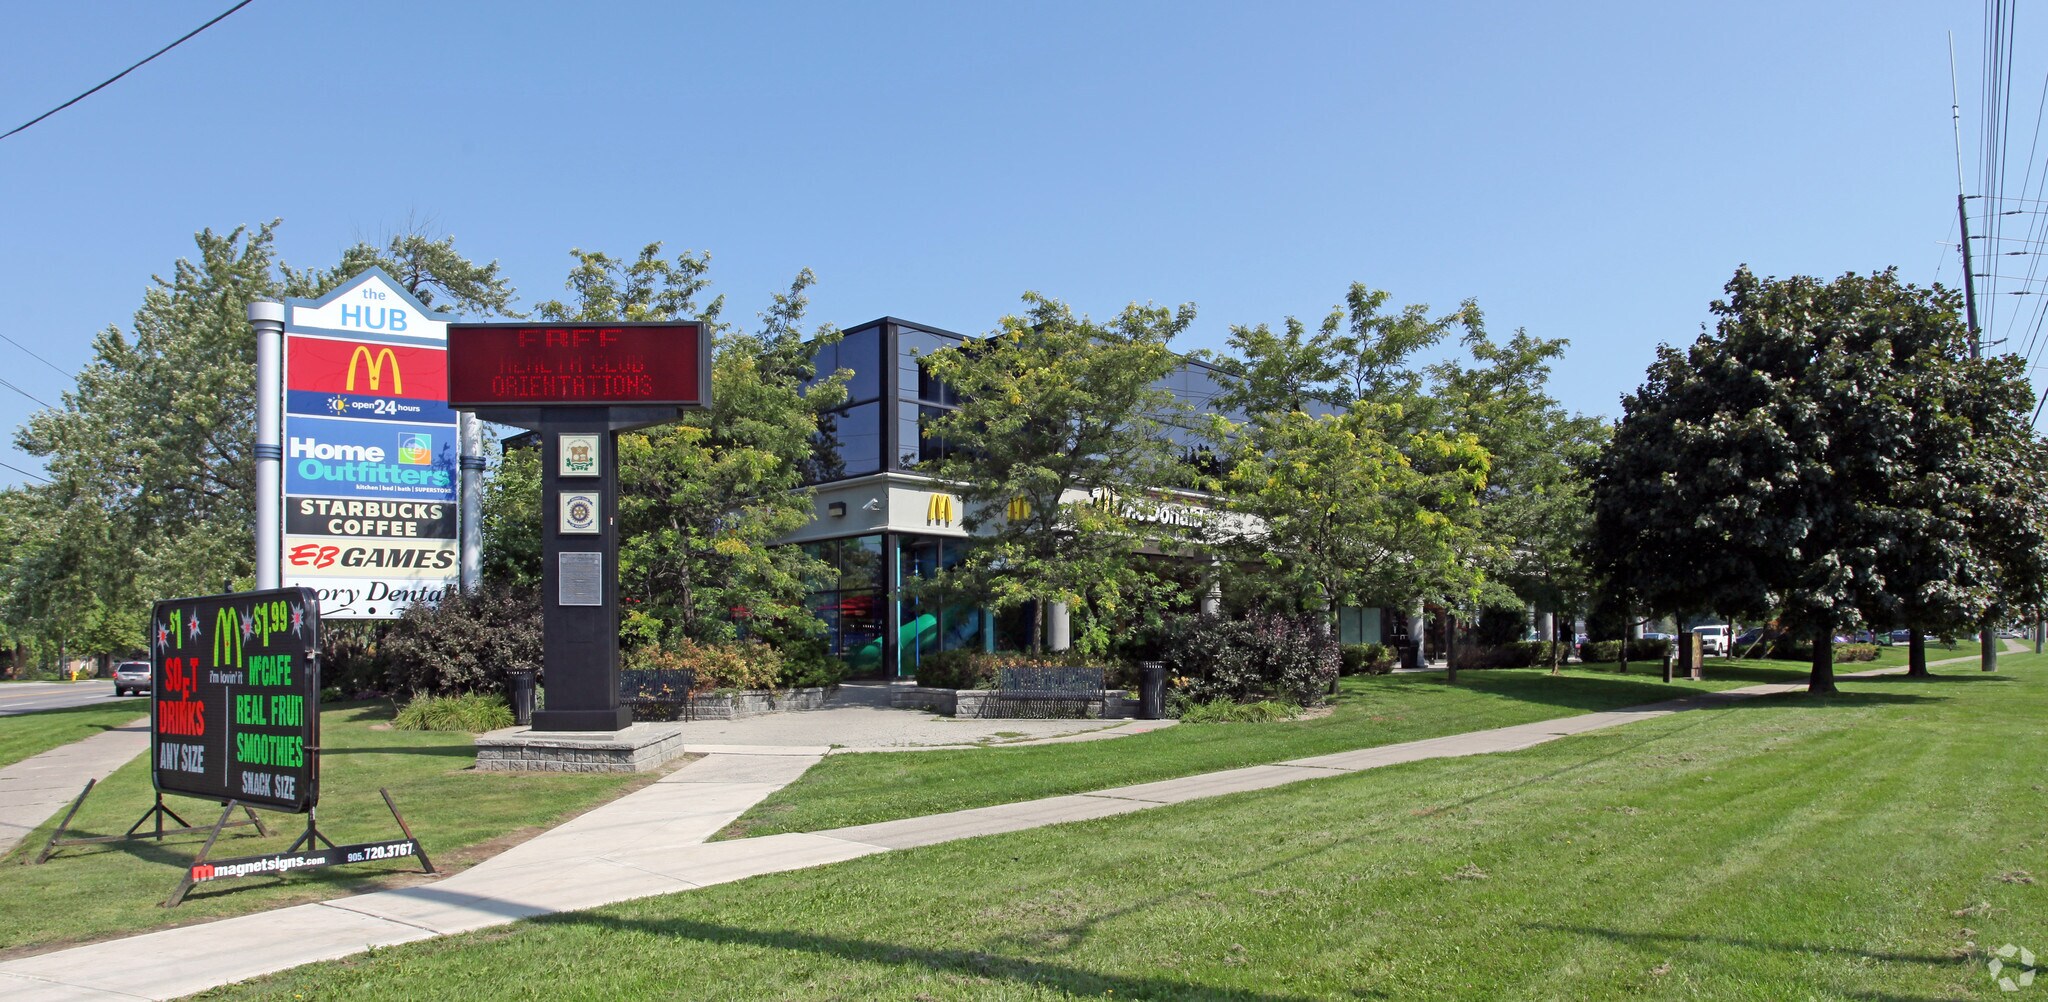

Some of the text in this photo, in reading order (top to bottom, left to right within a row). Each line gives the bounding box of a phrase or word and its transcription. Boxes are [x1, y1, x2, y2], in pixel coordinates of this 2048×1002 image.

[362, 288, 386, 300] the
[341, 303, 408, 331] HUB
[492, 375, 653, 398] ORIENTATIONS
[352, 399, 421, 415] open 24 hours
[290, 437, 385, 463] Home
[298, 459, 451, 487] Outfitters
[300, 499, 443, 520] STARBUCKS
[328, 518, 418, 537] COFFEE
[288, 544, 455, 569] EB GAMES
[308, 581, 450, 607] ory Denta
[169, 608, 182, 650] $1
[254, 600, 288, 647] $1.99
[165, 657, 199, 702] SOFT
[209, 671, 219, 683] i'm
[238, 671, 243, 684] it
[159, 700, 205, 736] DRINKS
[236, 694, 267, 725] REAL
[160, 742, 205, 774] ANY SIZE
[236, 732, 303, 768] SMOOTHIES
[242, 770, 296, 800] SNACK SIZE
[214, 855, 325, 880] magnetsigns.com
[347, 842, 413, 863] 905.720.3767
